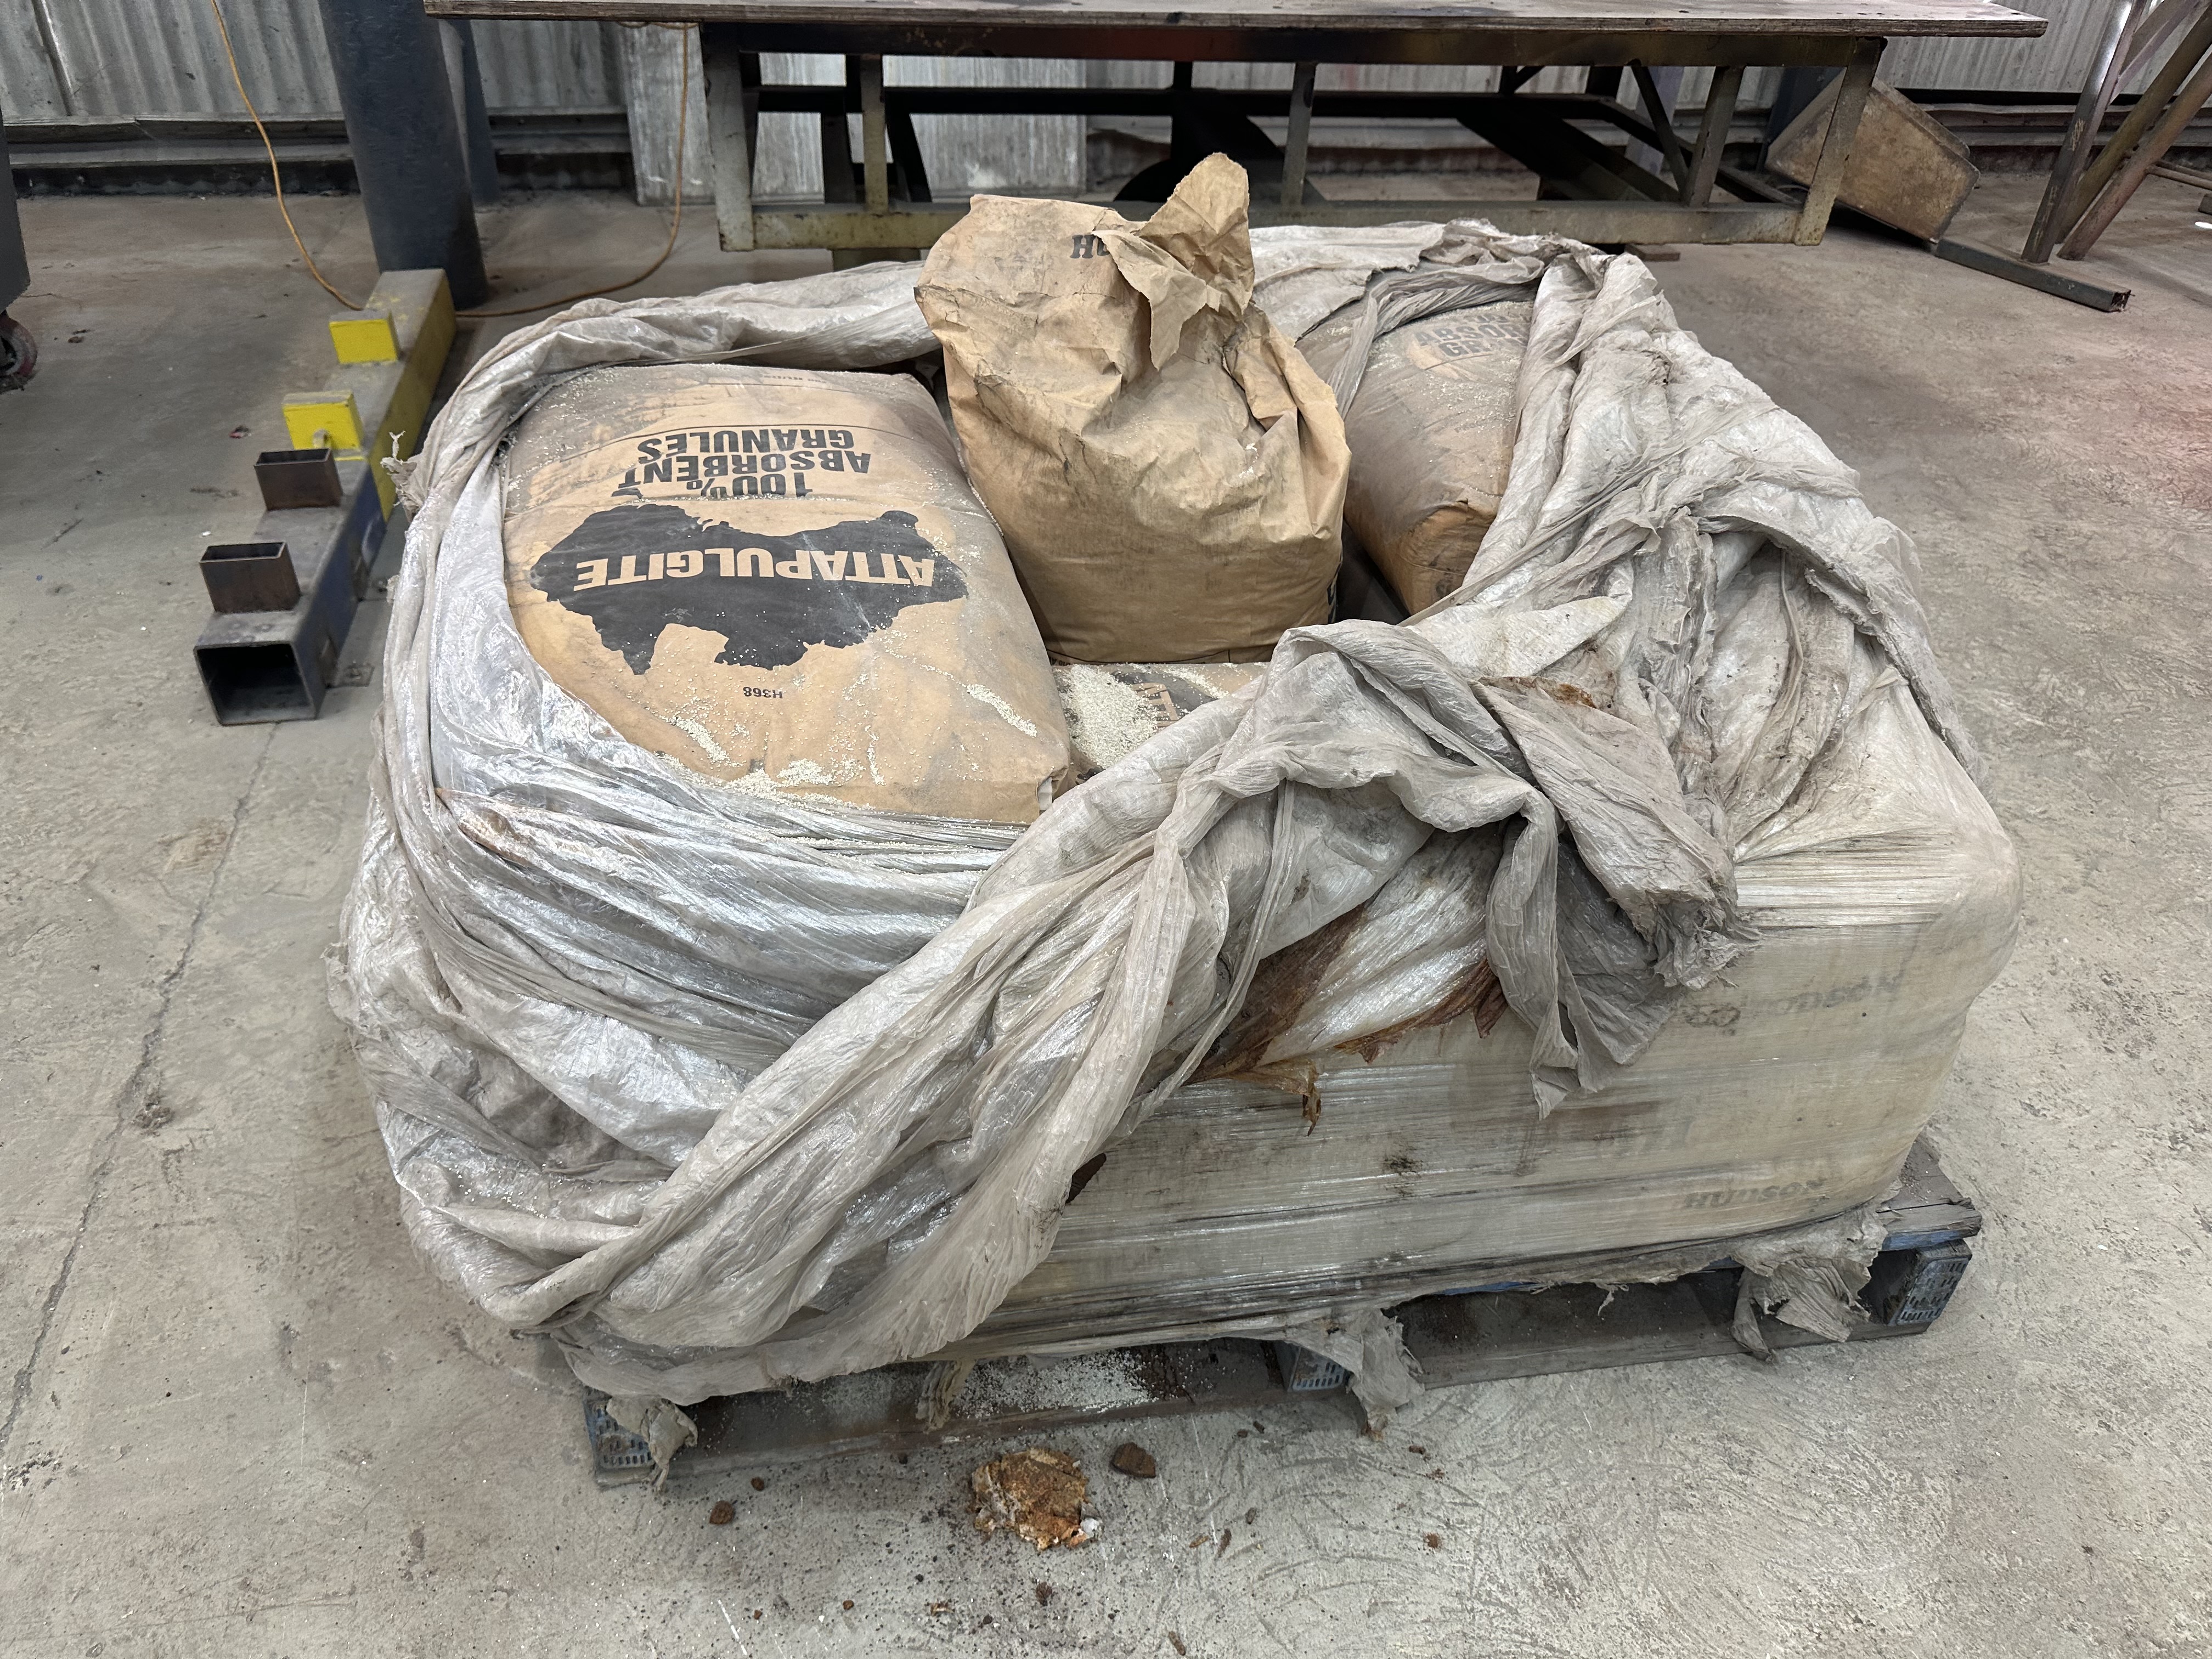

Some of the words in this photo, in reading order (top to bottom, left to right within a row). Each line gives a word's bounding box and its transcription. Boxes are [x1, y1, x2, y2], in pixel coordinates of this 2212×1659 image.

[1414, 324, 1528, 347] ABSOR
[637, 429, 854, 464] GRANULES
[618, 450, 871, 488] ABSORBENT
[686, 472, 814, 498] 100%
[573, 548, 934, 591] ATTAPULGITE
[743, 686, 783, 699] H368
